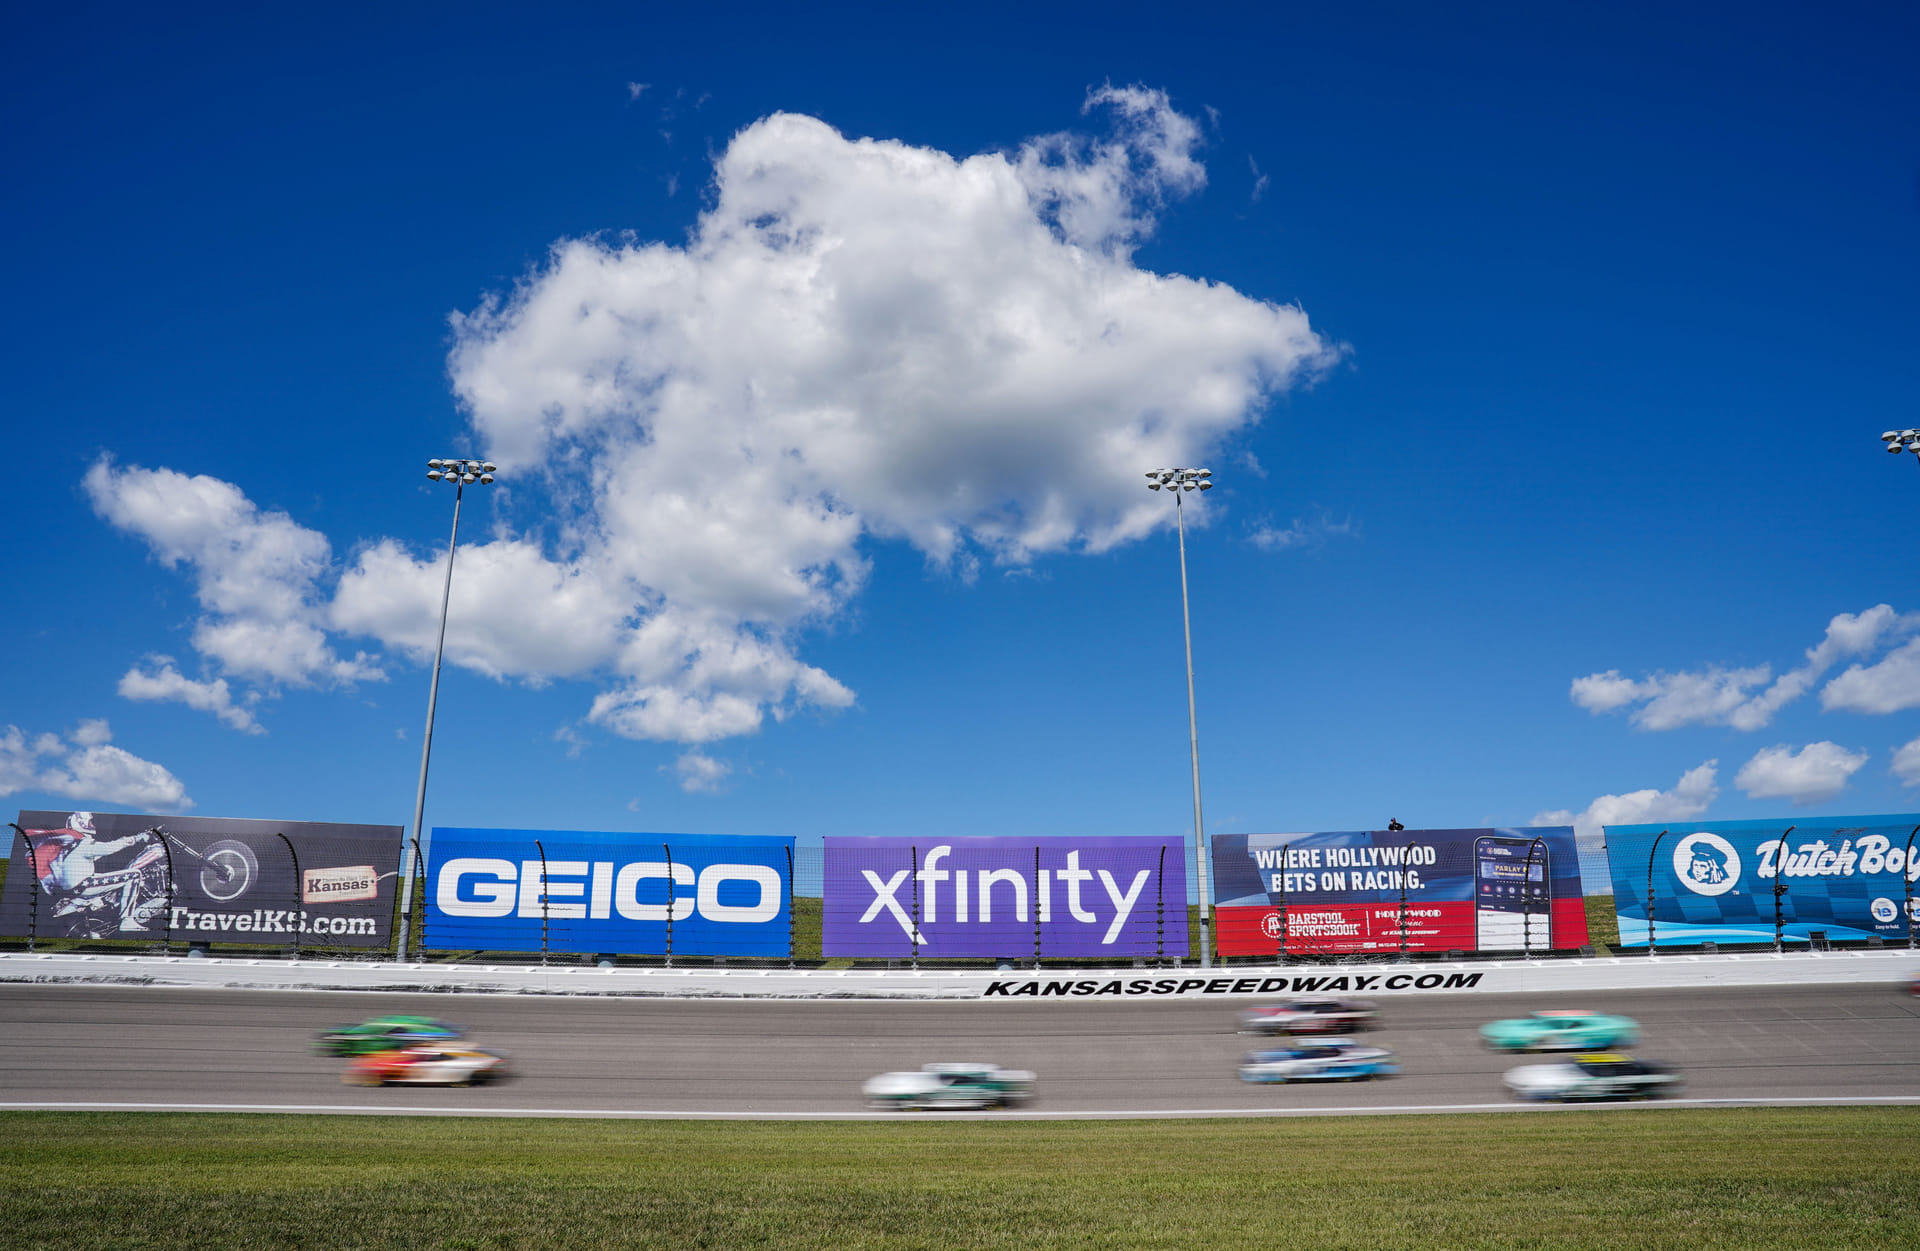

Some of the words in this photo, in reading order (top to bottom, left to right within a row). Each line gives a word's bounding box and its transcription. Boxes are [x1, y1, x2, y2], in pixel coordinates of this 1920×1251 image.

[1255, 849, 1321, 869] WHERE
[1325, 846, 1436, 868] HOLLYWOOD
[1756, 839, 1858, 879] Dutch
[307, 878, 369, 893] Kansas
[436, 858, 782, 924] GEICO
[1271, 872, 1316, 893] BETS
[1321, 871, 1347, 892] ON
[1352, 870, 1426, 891] RACING.
[859, 845, 1151, 945] xfinity
[168, 906, 376, 935] TravelKS.com
[1288, 912, 1346, 924] BARSTOOL
[1289, 924, 1360, 937] SPORTSBOOK
[983, 972, 1485, 997] KANSASSPEEDWAY.COM
